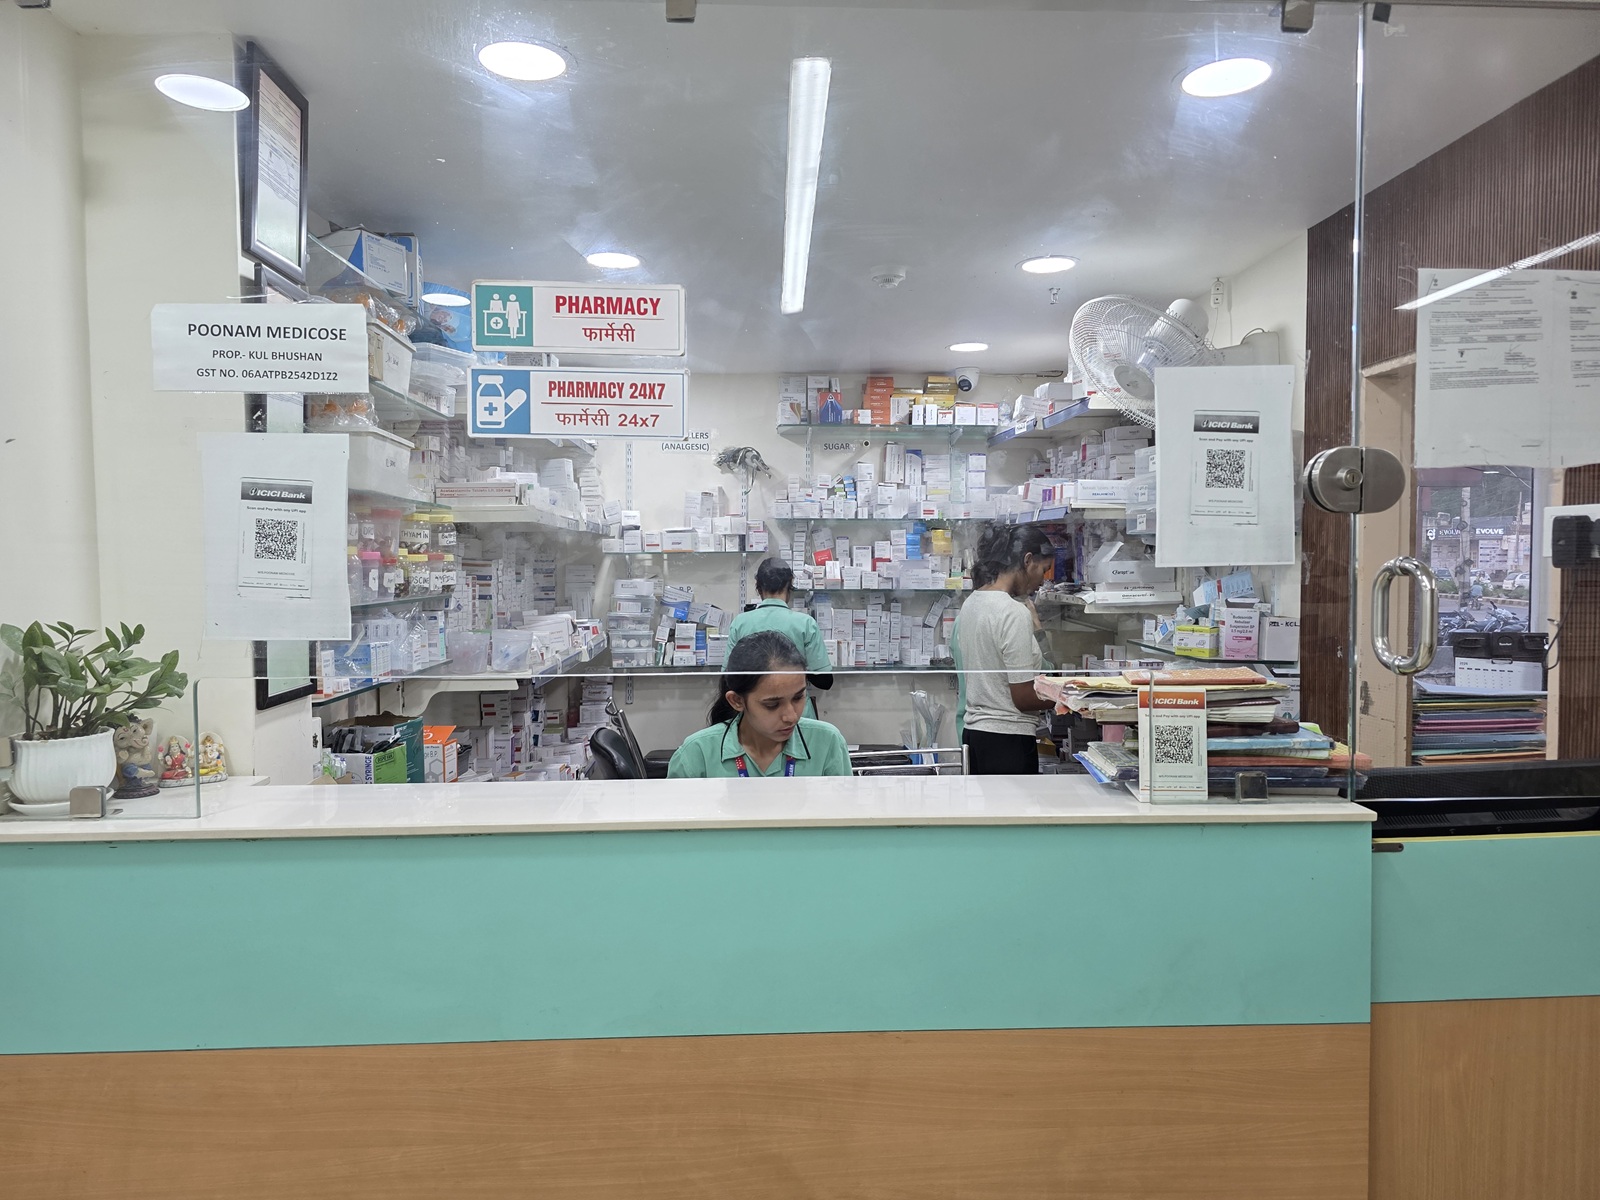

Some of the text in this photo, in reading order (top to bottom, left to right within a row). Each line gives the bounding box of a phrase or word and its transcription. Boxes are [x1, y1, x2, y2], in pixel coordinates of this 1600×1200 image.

[555, 295, 661, 316] PHARMACY
[188, 323, 347, 341] POONAM MEDICOSE
[582, 323, 635, 342] फार्मेसी
[212, 350, 323, 362] PROP.- KUL BHUSHAN
[196, 368, 339, 381] GST NO. 06AATPB2542D1Z2
[548, 381, 666, 400] PHARMACY 24X7
[555, 408, 660, 427] फार्मेसी 24x7
[1208, 421, 1254, 430] ICICI Bank
[661, 443, 710, 452] (ANALGESIC)
[257, 489, 306, 499] ICICI Bank
[365, 756, 373, 780] SYRINGE
